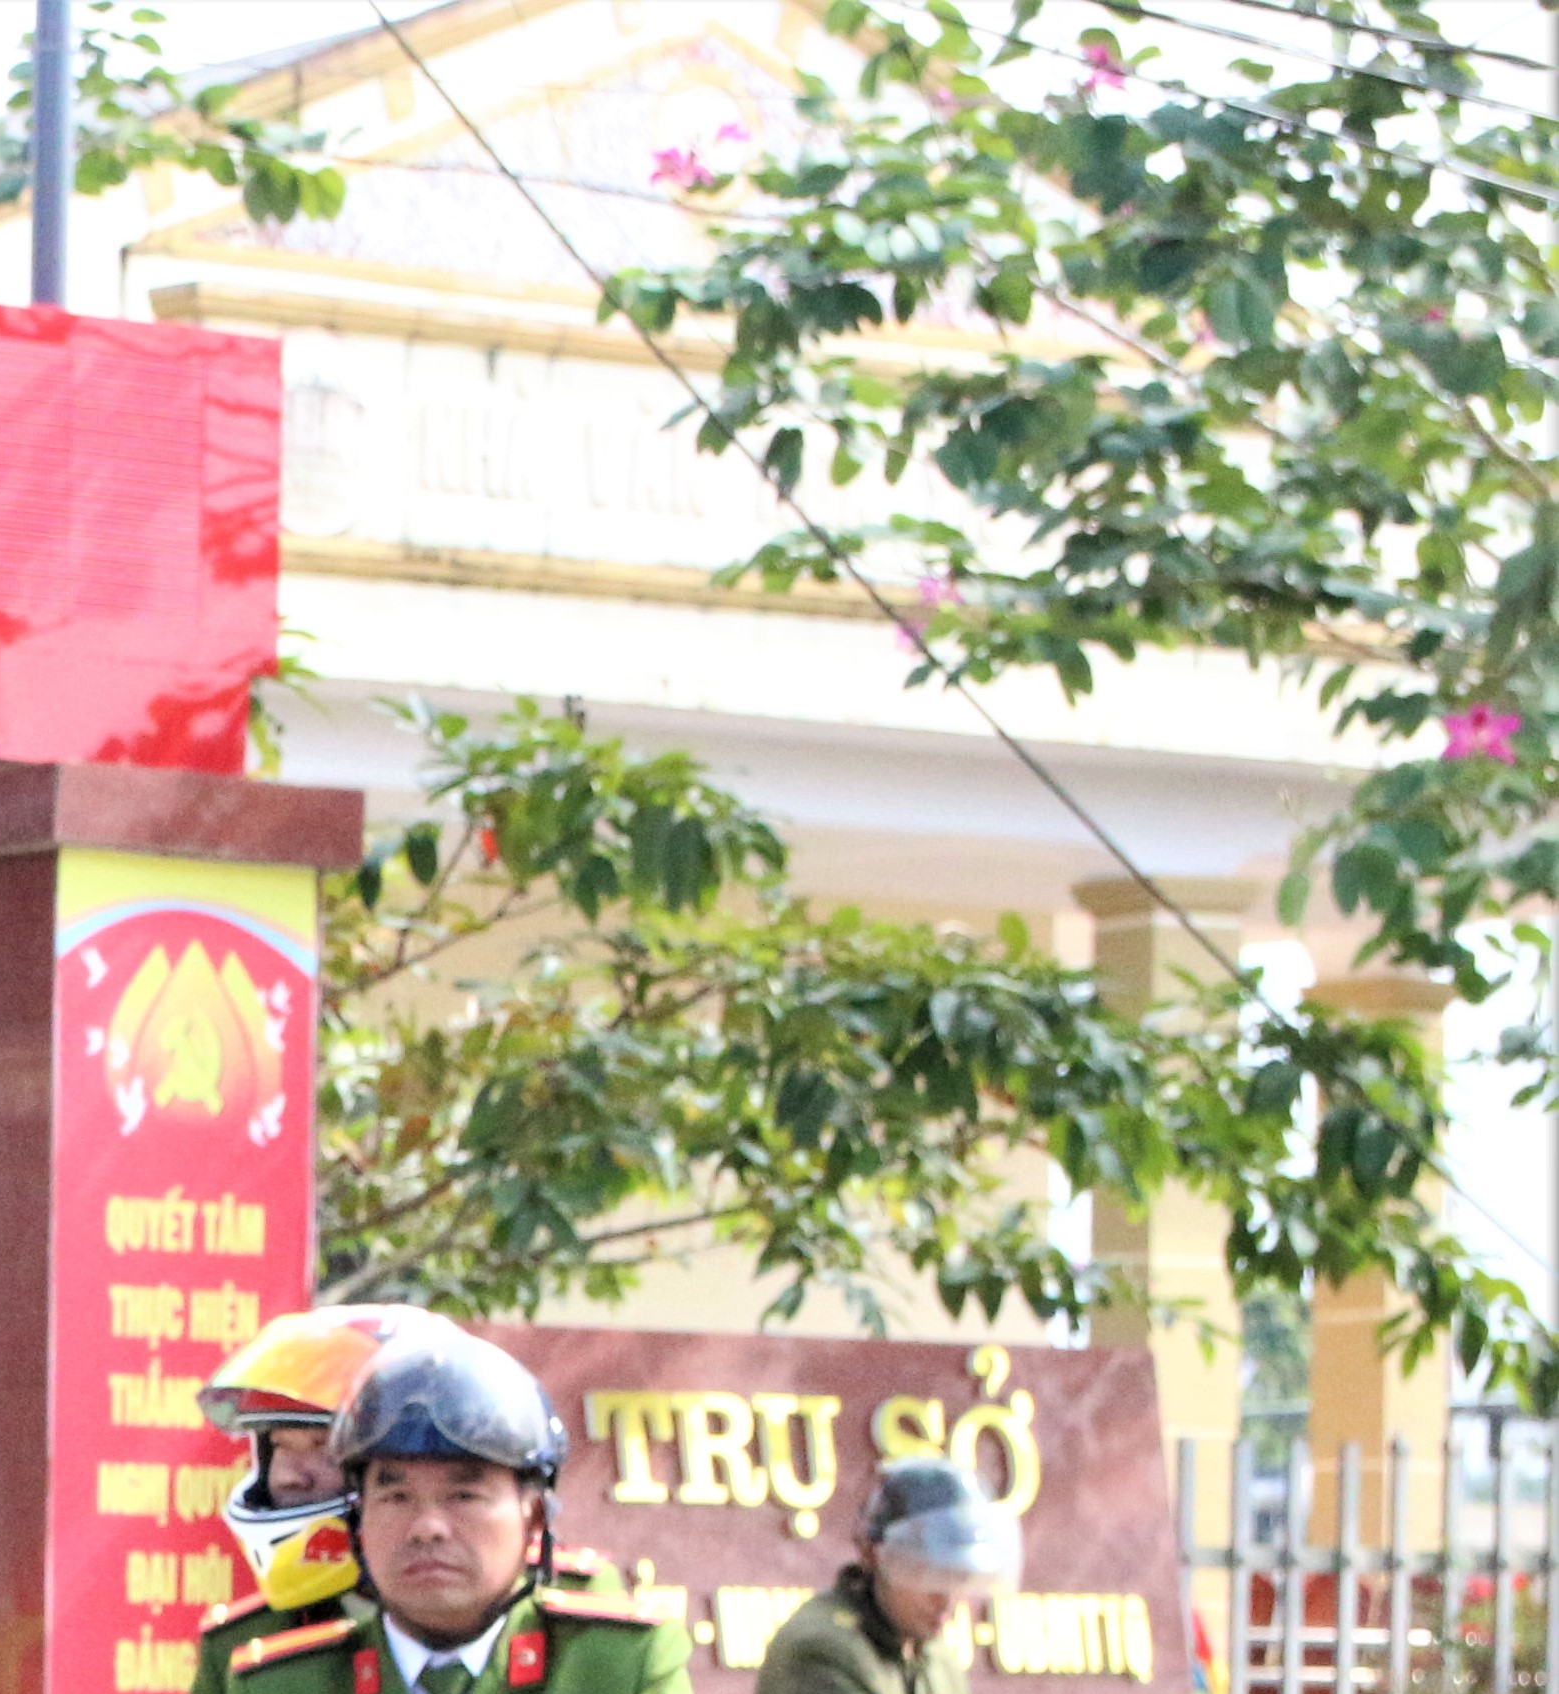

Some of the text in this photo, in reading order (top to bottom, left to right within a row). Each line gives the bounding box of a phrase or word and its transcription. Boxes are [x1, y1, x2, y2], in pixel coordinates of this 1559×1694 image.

[105, 1184, 266, 1257] QUYẾT TÂM
[109, 1282, 185, 1351] THỰC
[584, 1390, 842, 1540] TRỤ
